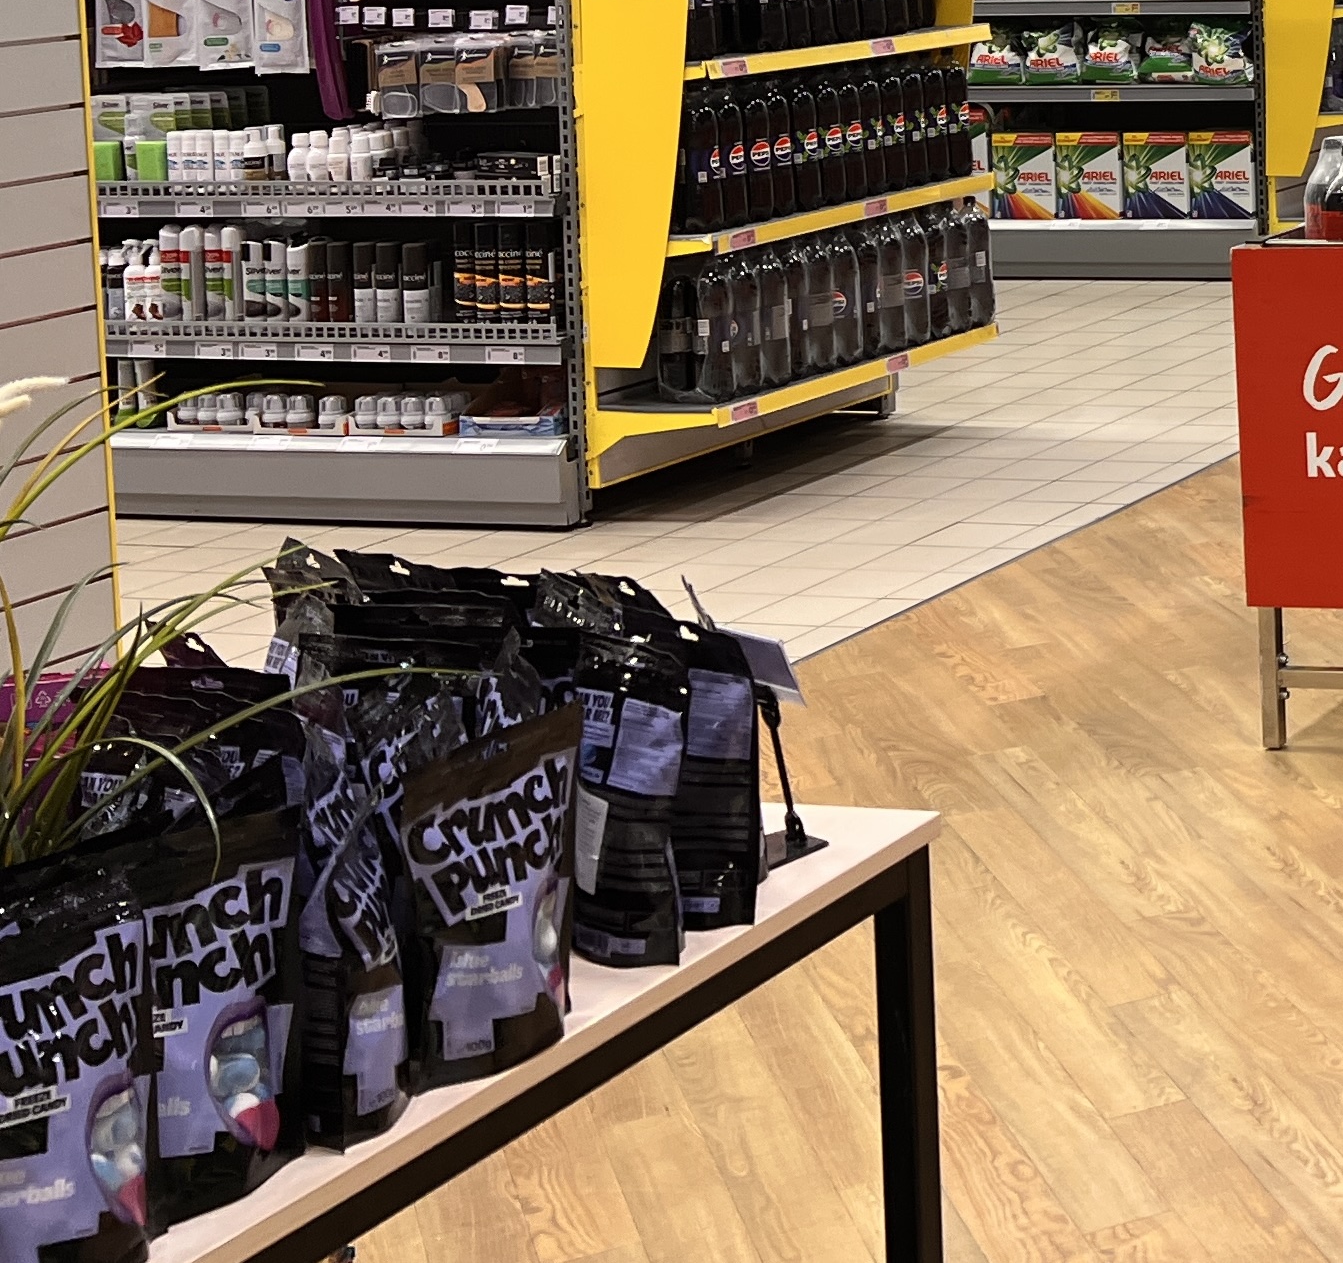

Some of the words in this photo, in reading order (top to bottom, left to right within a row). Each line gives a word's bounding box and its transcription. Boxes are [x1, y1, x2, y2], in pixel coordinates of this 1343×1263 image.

[1018, 172, 1051, 182] ARIEL
[1082, 171, 1117, 181] ARIEL
[1150, 171, 1184, 181] ARIEL
[1215, 170, 1250, 181] ARIEL
[149, 866, 285, 960] nch
[0, 931, 138, 1038] unch
[154, 930, 273, 1009] nch
[0, 996, 138, 1097] unch
